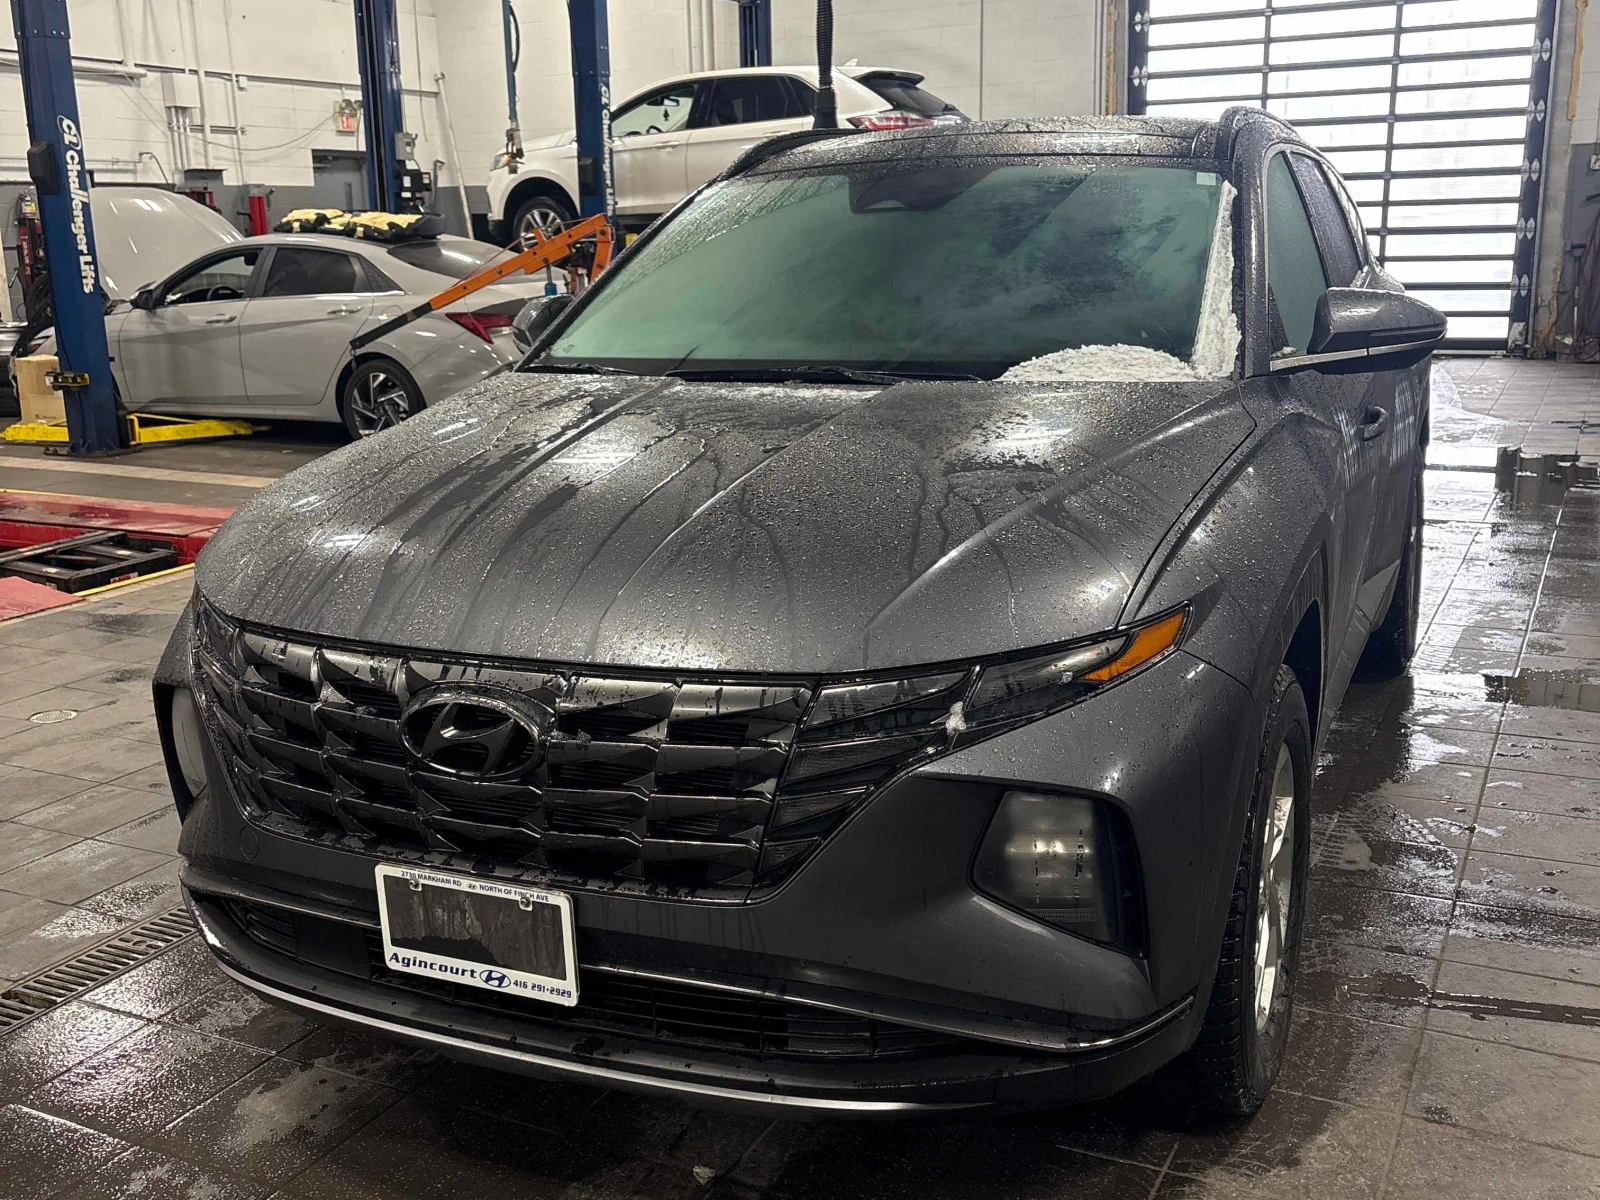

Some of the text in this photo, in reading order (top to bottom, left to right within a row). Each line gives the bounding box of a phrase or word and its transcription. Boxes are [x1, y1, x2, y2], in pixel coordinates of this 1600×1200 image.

[602, 109, 613, 186] Challenger
[66, 150, 89, 254] Challenger
[79, 255, 94, 294] Lifts
[400, 870, 417, 879] 2730
[417, 873, 452, 885] MARKHAM
[452, 879, 462, 887] RD
[479, 884, 502, 894] NORTH
[514, 890, 535, 899] FINCH
[535, 894, 549, 902] AVE
[388, 952, 478, 979] Agincourt
[513, 979, 528, 989] 416
